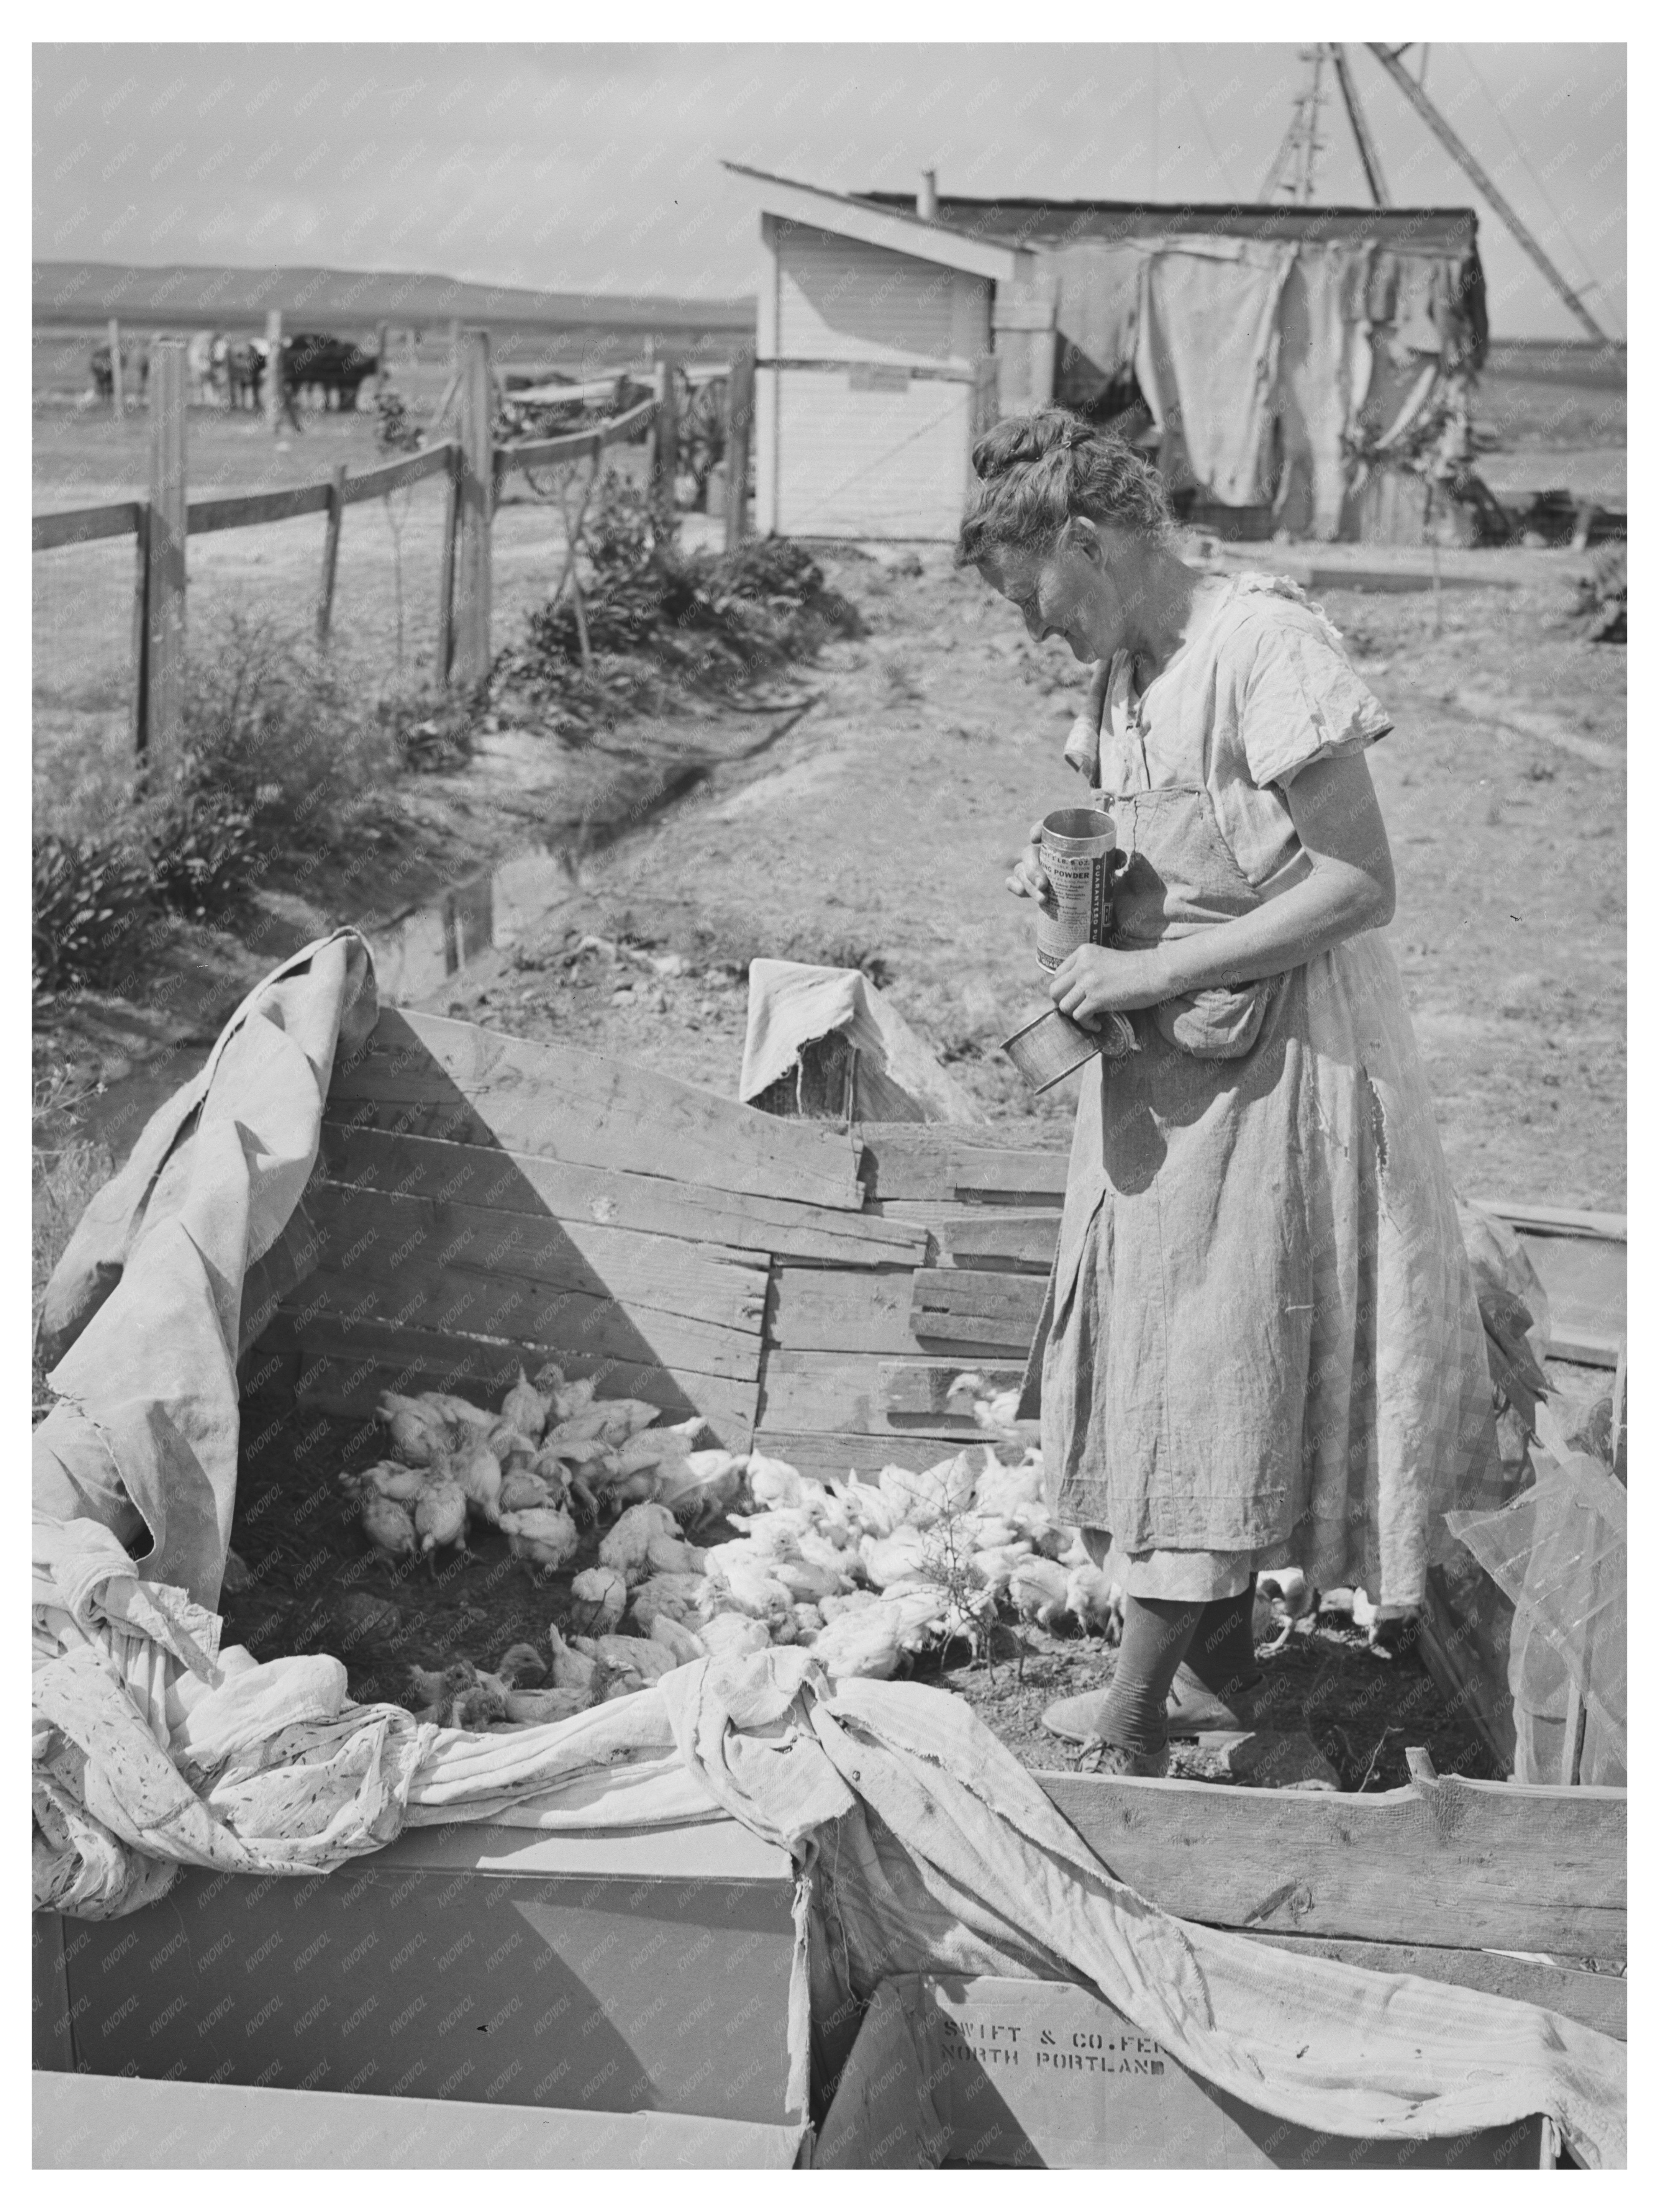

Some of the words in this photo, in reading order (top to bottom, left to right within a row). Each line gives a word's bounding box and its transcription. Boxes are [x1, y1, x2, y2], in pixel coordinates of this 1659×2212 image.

[1054, 869, 1089, 879] POWDER
[944, 2021, 1021, 2042] SWIFT
[1041, 2030, 1056, 2045] &
[942, 2044, 1018, 2065] NORTH
